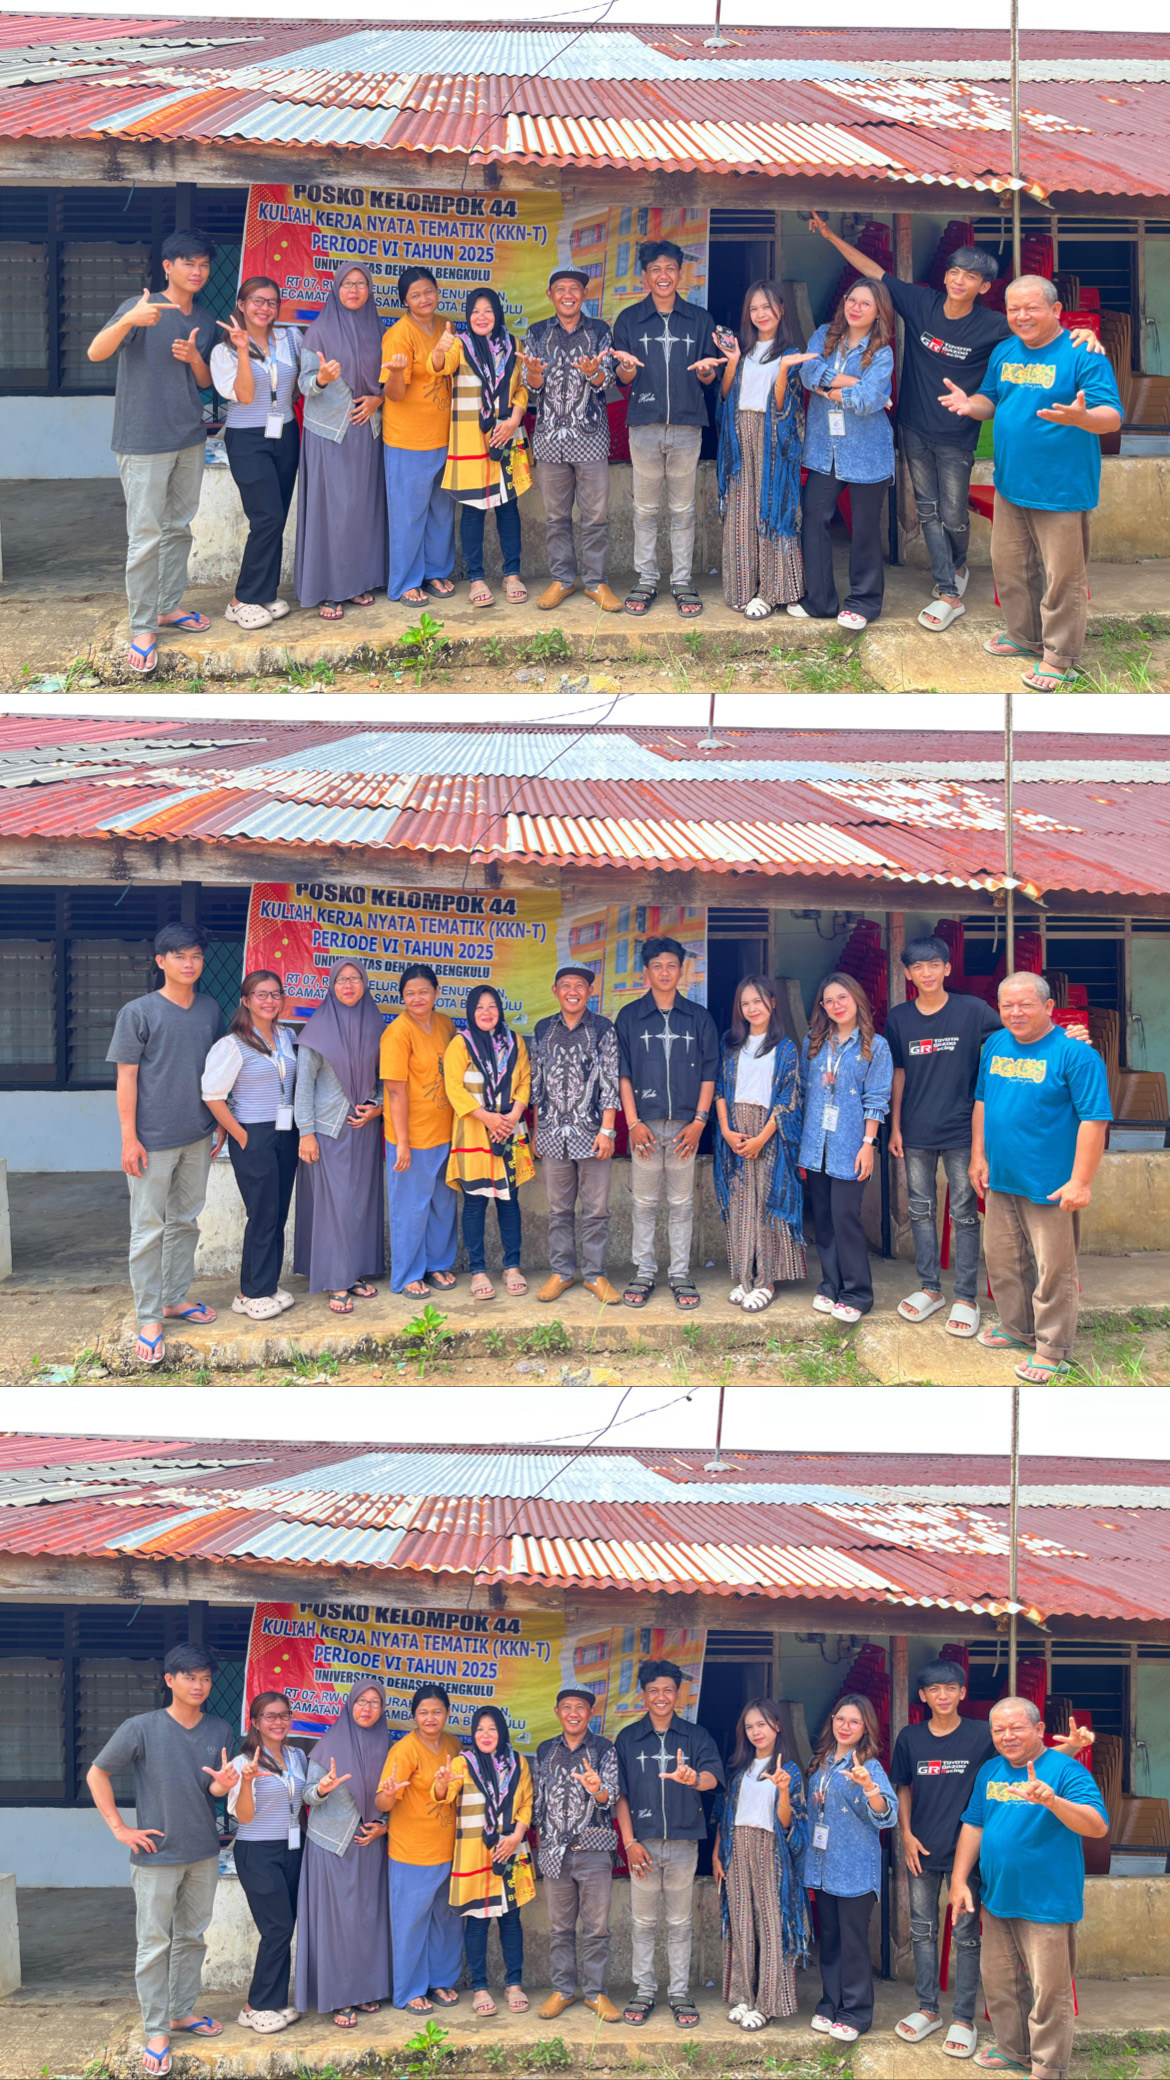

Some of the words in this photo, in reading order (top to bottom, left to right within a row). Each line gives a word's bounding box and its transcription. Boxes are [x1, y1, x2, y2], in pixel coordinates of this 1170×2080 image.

[294, 185, 364, 206] POSKO
[371, 190, 485, 216] KELOMPOK
[490, 199, 517, 217] 44
[259, 203, 311, 225] KULIAH
[316, 210, 362, 230] KERJA
[367, 215, 415, 235] NYATA
[419, 220, 485, 239] TEMATIK
[489, 223, 547, 246] (KKN-T)
[312, 233, 378, 255] PERIODE
[382, 240, 399, 257] VI
[403, 242, 453, 260] TAHUN
[458, 246, 494, 263] 2025
[286, 276, 301, 287] RT
[303, 277, 319, 290] 07,
[436, 267, 491, 282] BENGKULU
[436, 301, 458, 312] OTA
[296, 883, 366, 905] POSKO
[372, 888, 484, 914] KELOMPOK
[489, 898, 517, 915] 44
[260, 900, 313, 922] KULIAH
[317, 907, 363, 928] KERJA
[367, 913, 416, 932] NYATA
[420, 917, 485, 937] TEMATIK
[489, 920, 546, 943] (KKN-T)
[312, 930, 378, 953] PERIODE
[383, 938, 399, 954] VI
[403, 939, 453, 958] TAHUN
[458, 943, 494, 960] 2025
[286, 973, 301, 984] RT
[303, 974, 319, 988] 07,
[436, 964, 490, 979] BENGKULU
[434, 998, 457, 1008] OTA
[375, 1607, 489, 1633] KELOMPOK
[493, 1617, 521, 1635] 44
[262, 1617, 316, 1638] KULIAH
[320, 1624, 366, 1645] KERJA
[370, 1630, 419, 1650] NYATA
[423, 1634, 489, 1655] TEMATIK
[493, 1639, 551, 1662] (KKN-T)
[314, 1645, 381, 1669] PERIODE
[385, 1655, 402, 1671] VI
[406, 1657, 457, 1677] TAHUN
[461, 1661, 498, 1679] 2025
[285, 1688, 299, 1699] RT
[301, 1690, 317, 1703] 07,
[322, 1691, 340, 1702] RW
[918, 1766, 940, 1774] GR
